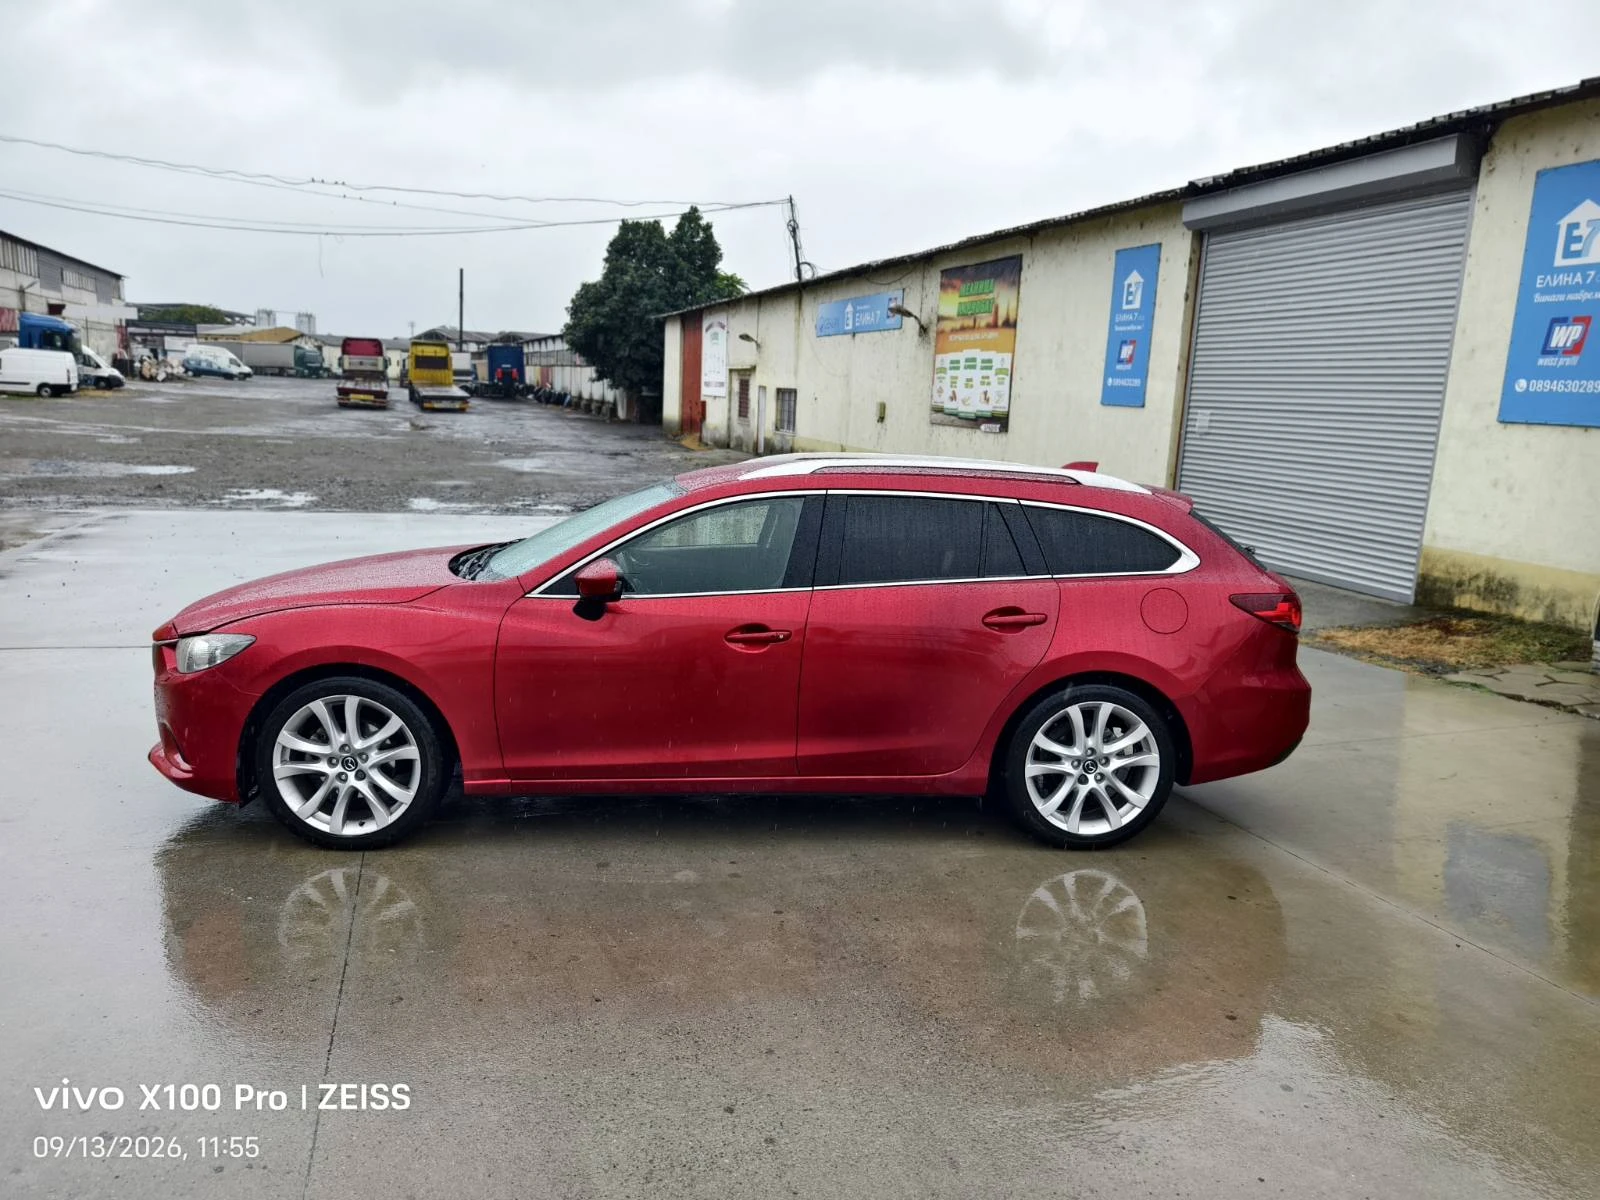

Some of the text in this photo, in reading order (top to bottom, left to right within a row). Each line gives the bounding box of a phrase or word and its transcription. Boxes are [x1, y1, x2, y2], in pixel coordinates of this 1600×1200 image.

[1536, 272, 1582, 288] ЕЛИНА
[1586, 270, 1596, 284] 7
[854, 311, 875, 327] ЕЛИНА
[875, 310, 880, 325] 7
[1550, 325, 1583, 348] WP
[1529, 379, 1600, 393] 0894630289
